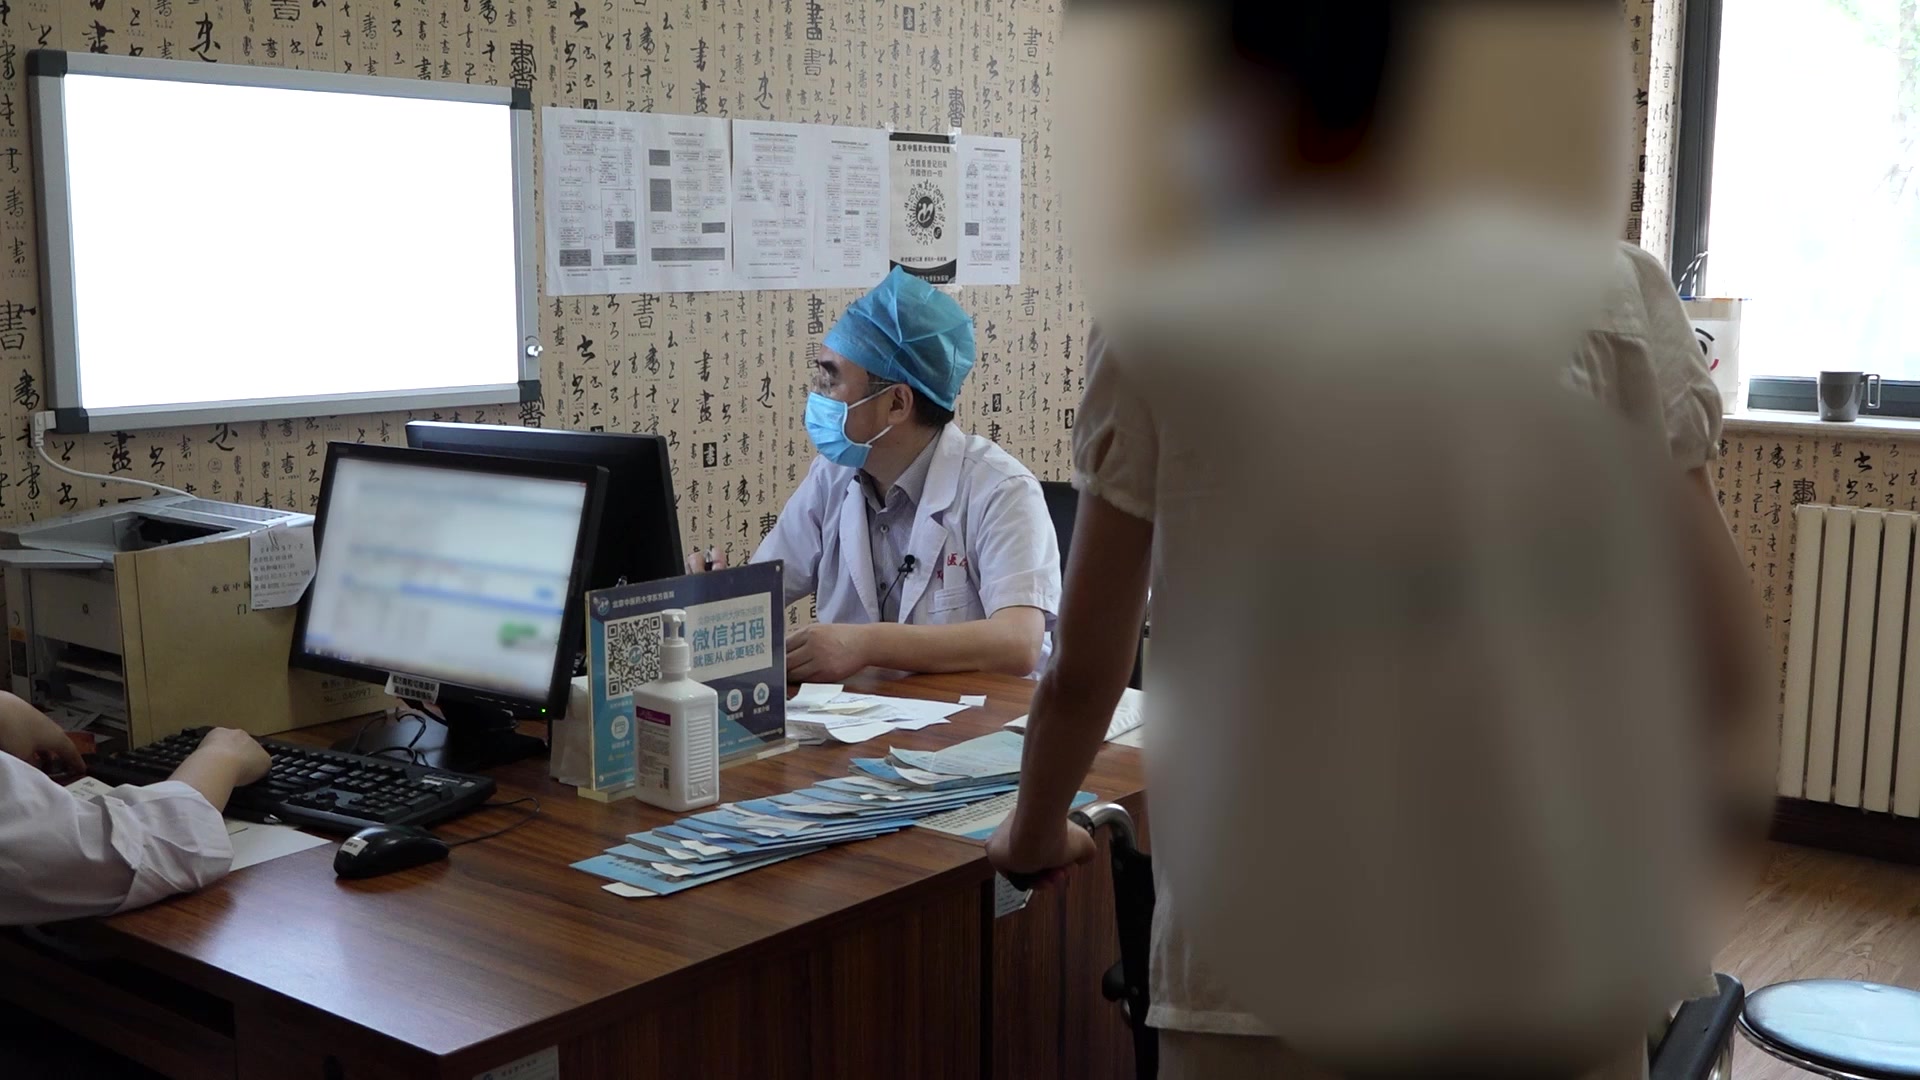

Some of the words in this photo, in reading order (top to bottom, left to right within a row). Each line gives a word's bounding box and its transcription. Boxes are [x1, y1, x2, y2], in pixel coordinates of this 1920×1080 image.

[612, 591, 675, 608] 北京中医药大学东方医院
[692, 617, 765, 652] 微信扫码
[693, 642, 765, 668] 就医从此更轻松
